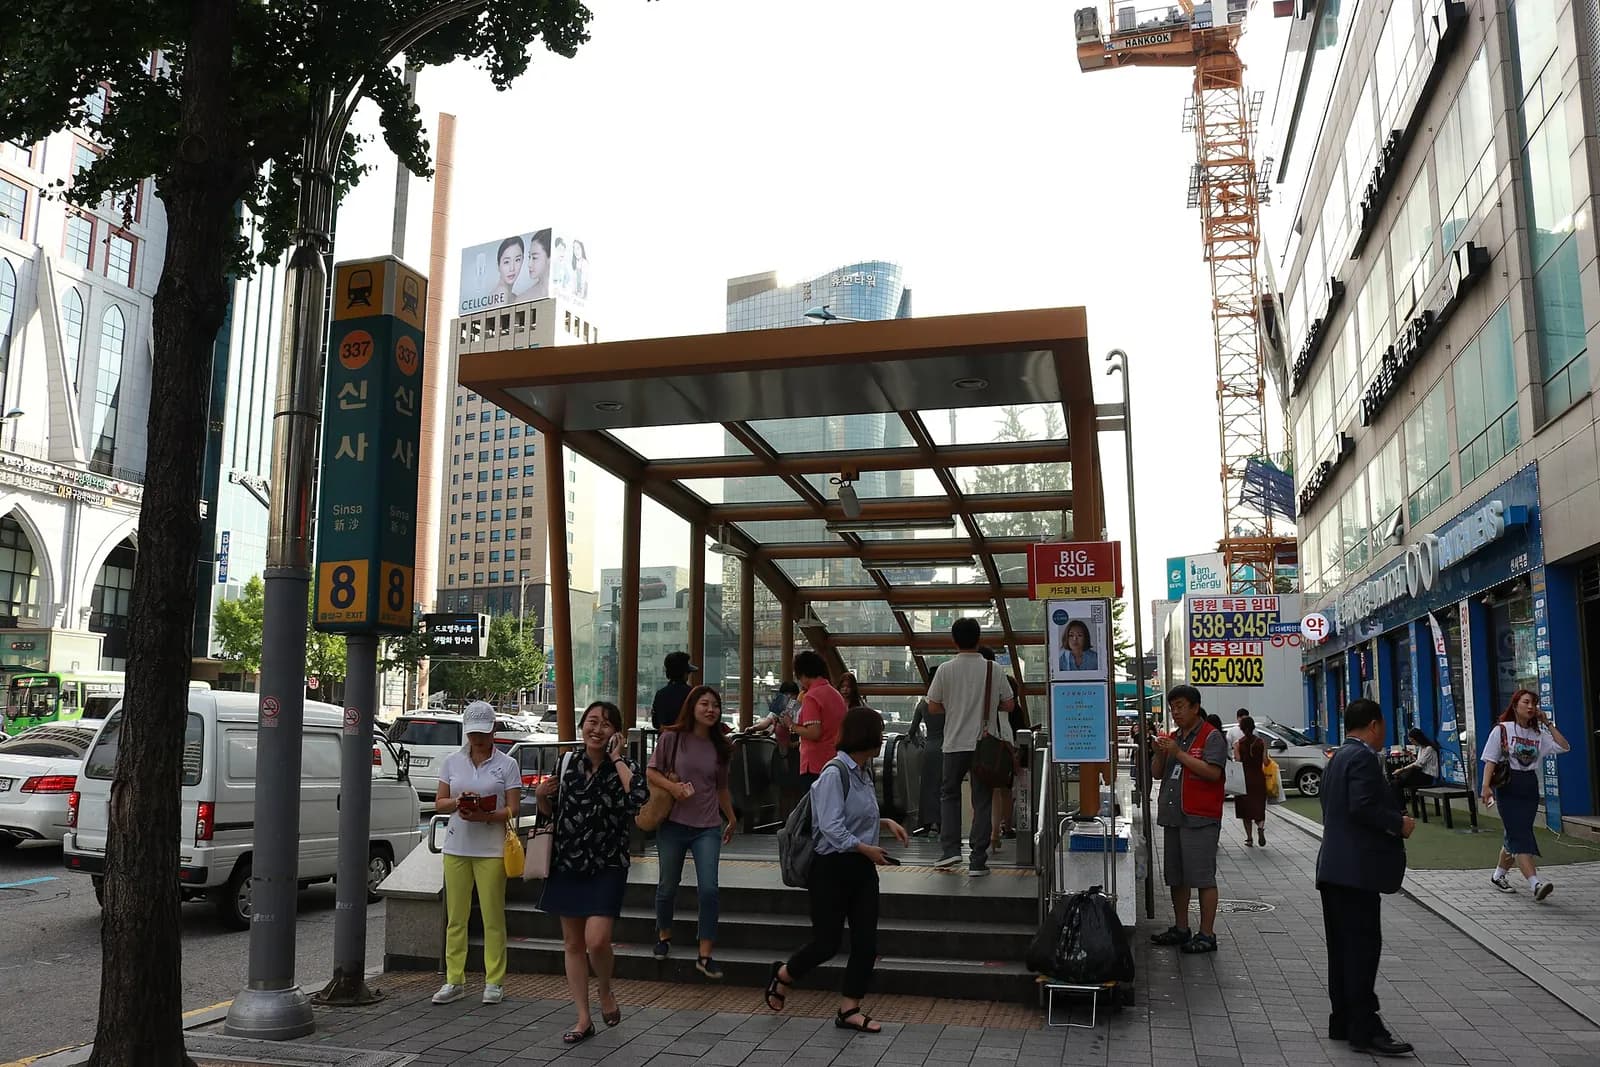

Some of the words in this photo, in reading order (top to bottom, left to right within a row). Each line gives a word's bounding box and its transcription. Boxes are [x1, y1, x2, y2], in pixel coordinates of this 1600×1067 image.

[1125, 33, 1170, 48] HANKOOK
[461, 293, 505, 311] CELLCURE
[342, 341, 371, 359] 337
[399, 345, 417, 366] 337
[334, 379, 369, 462] 신사
[392, 385, 415, 470] 신사
[333, 504, 362, 516] Sinsa
[1060, 551, 1088, 564] BIG
[1054, 563, 1096, 578] ISSUE
[1197, 572, 1217, 582] your
[331, 565, 355, 609] 8
[388, 567, 405, 612] 8
[1050, 586, 1077, 595] 카드결제
[1080, 585, 1101, 595] 됩니다
[1190, 579, 1221, 591] Energy
[1193, 599, 1217, 612] 병원
[1222, 598, 1247, 611] 특급
[1251, 598, 1276, 611] 임대
[346, 611, 364, 619] EXIT
[1306, 617, 1324, 636] 약
[454, 636, 473, 645] 합시다
[1191, 642, 1262, 656] 신축임대
[1191, 658, 1263, 683] 565-0303
